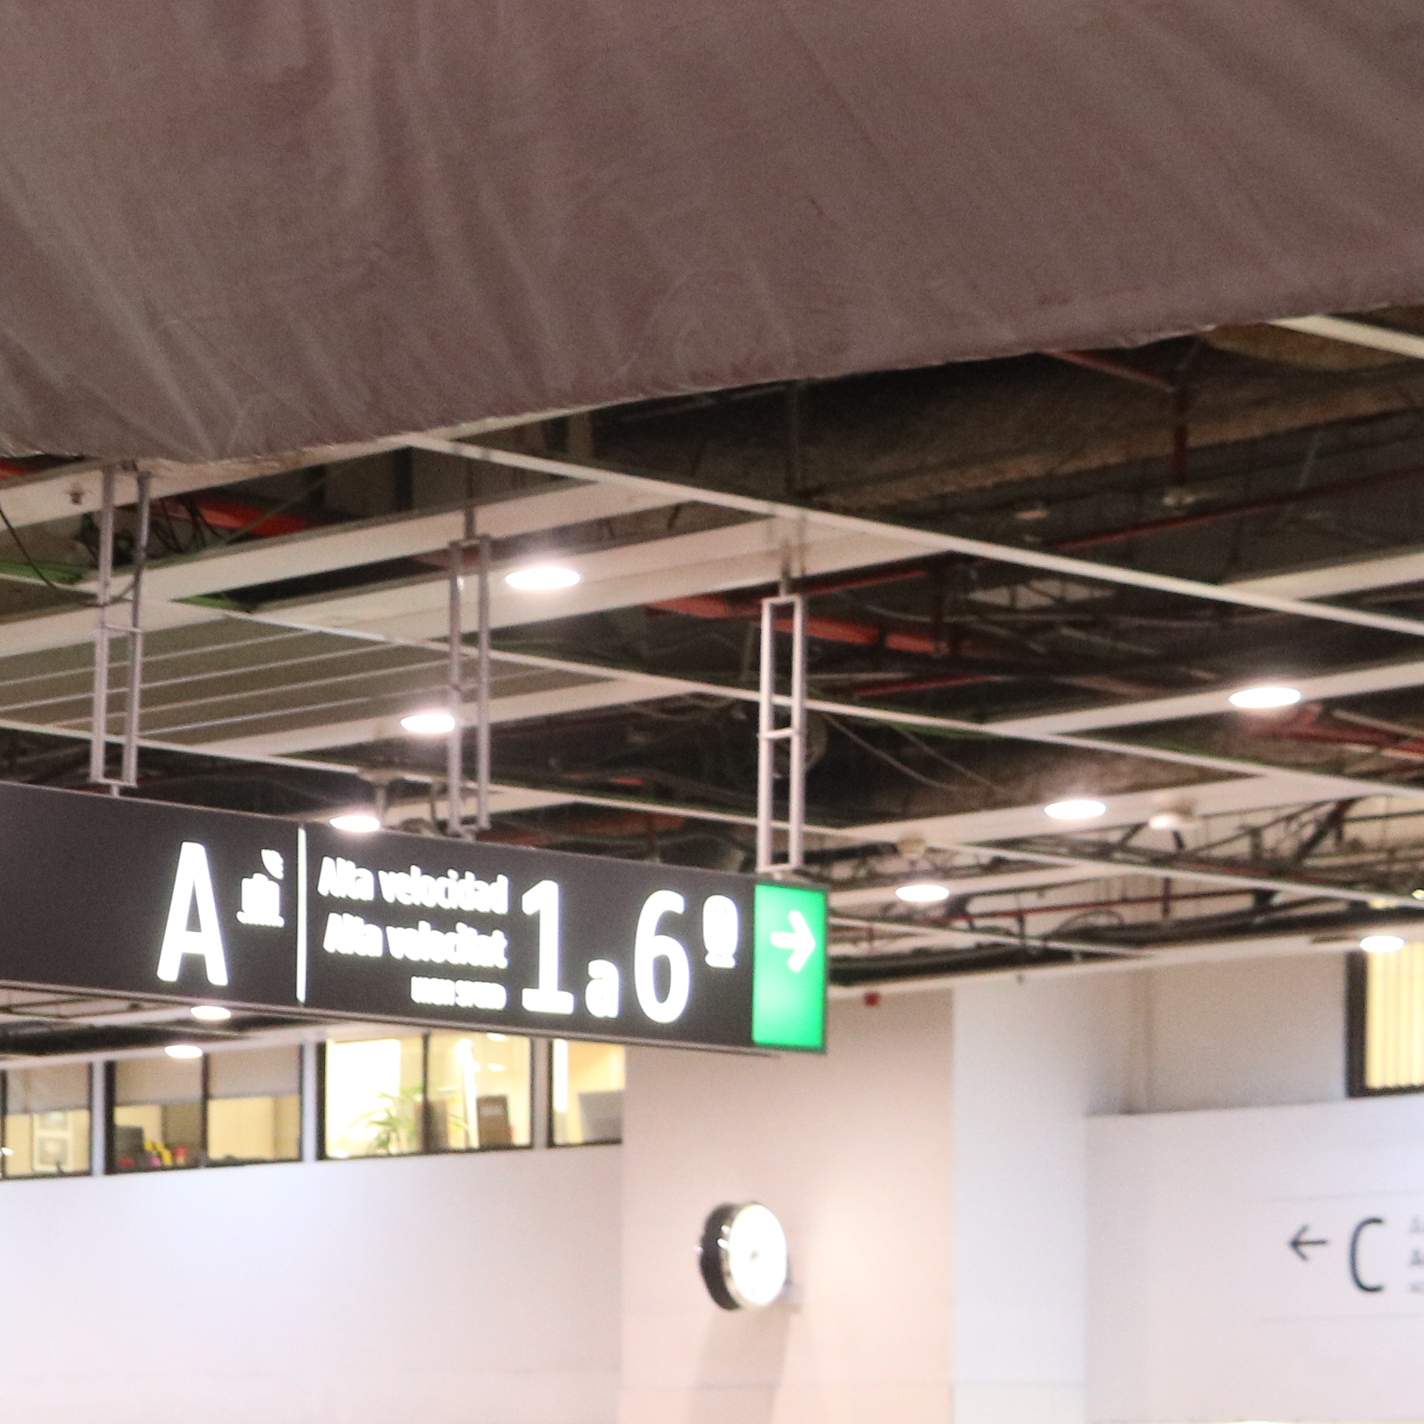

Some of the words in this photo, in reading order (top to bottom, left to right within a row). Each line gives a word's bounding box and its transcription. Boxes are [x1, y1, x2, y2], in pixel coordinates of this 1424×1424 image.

[157, 842, 228, 986] A
[318, 857, 375, 901] Alta
[378, 865, 509, 915] velocidad
[521, 879, 575, 1015] 1
[585, 958, 621, 1019] a
[633, 889, 692, 1024] 6
[1349, 1217, 1384, 1293] C
